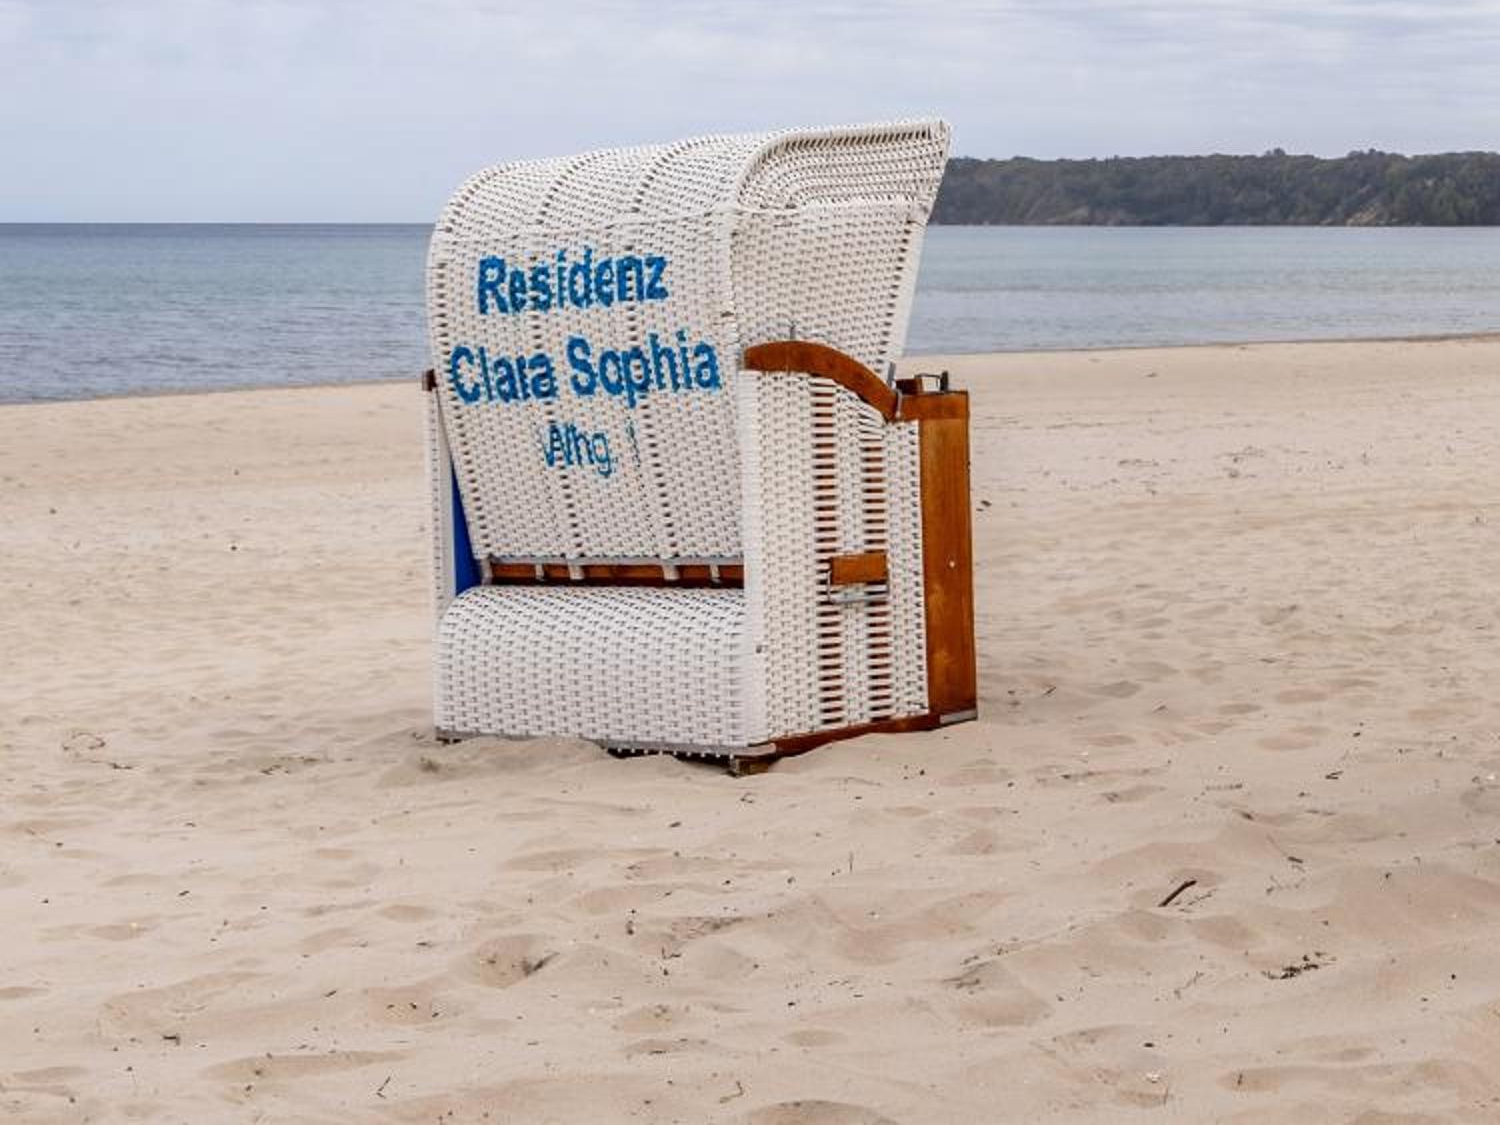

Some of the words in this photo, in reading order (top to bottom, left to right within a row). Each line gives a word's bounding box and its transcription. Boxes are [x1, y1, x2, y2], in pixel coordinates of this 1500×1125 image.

[476, 246, 671, 316] Residenz
[448, 345, 561, 406] Clara
[565, 330, 722, 410] Sophia
